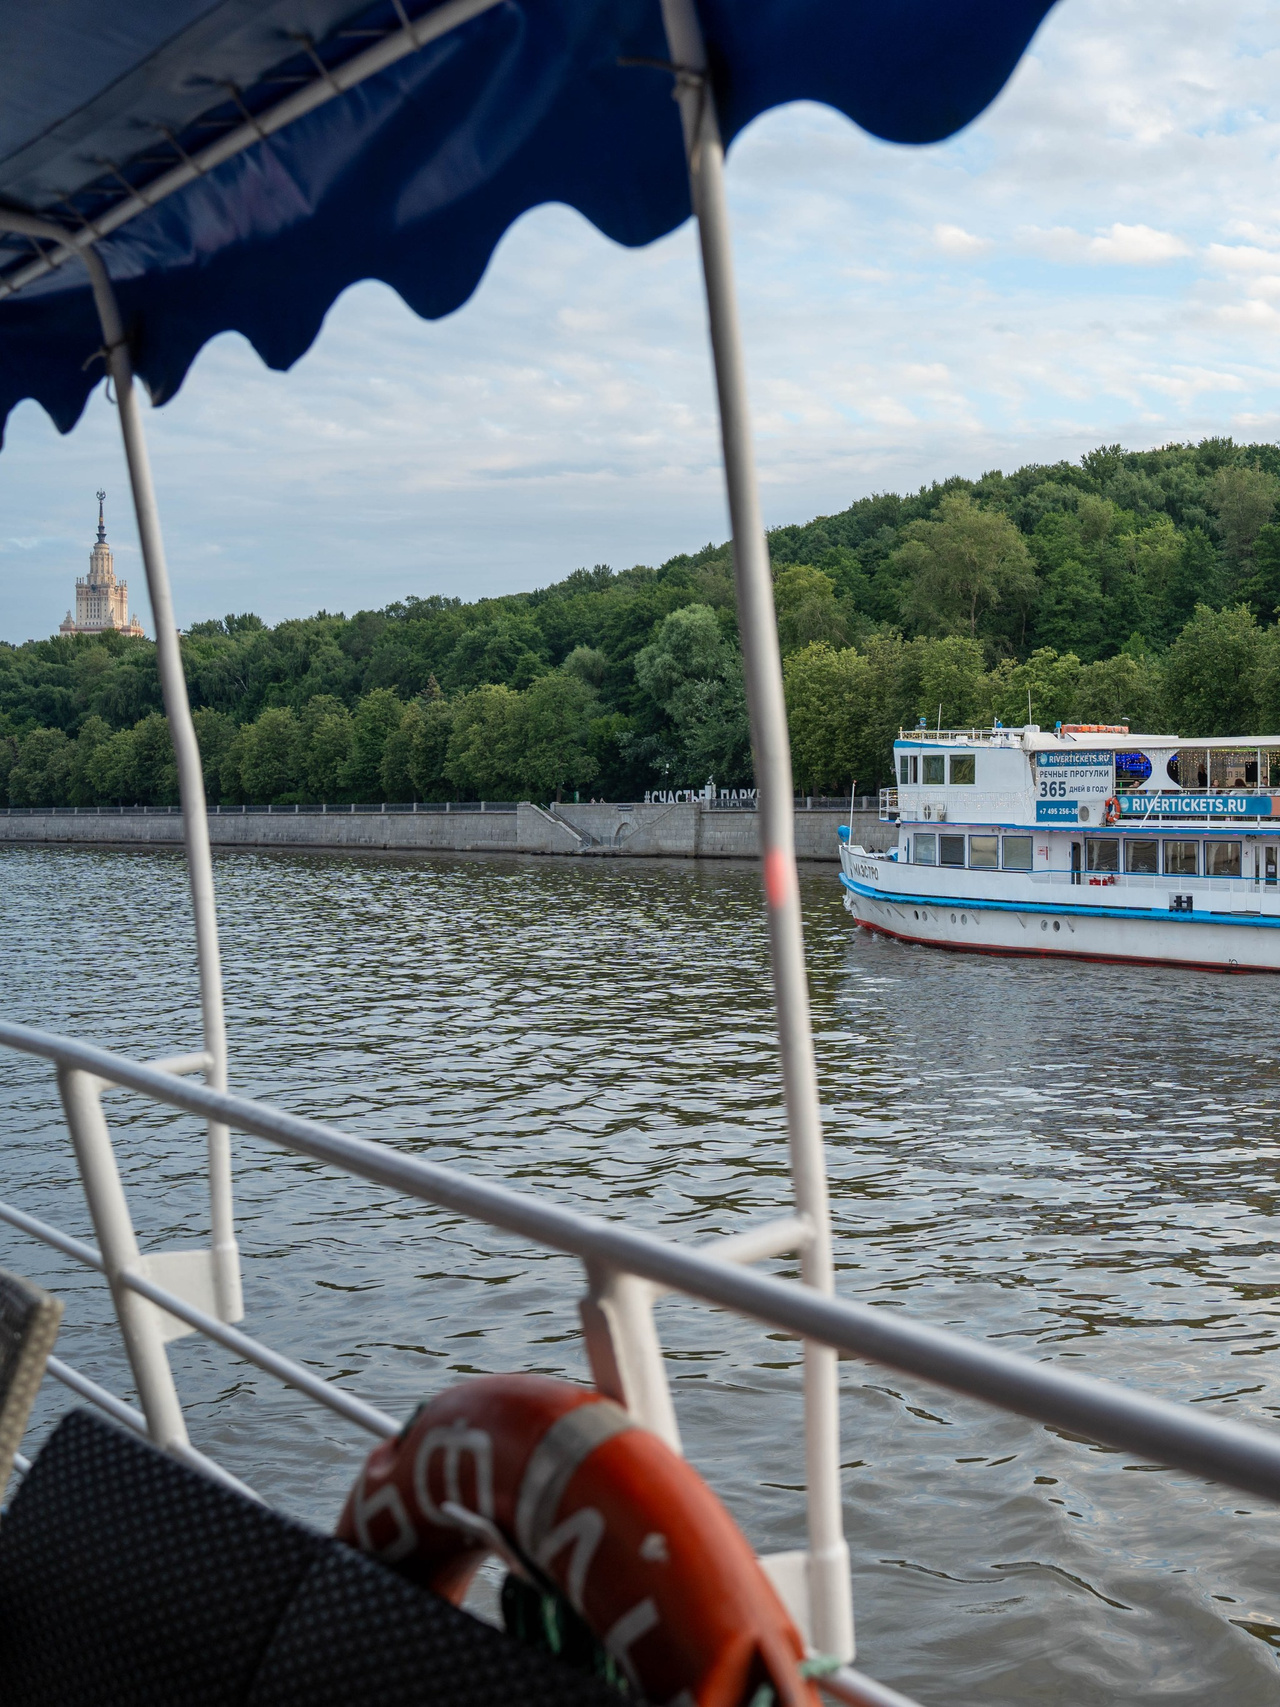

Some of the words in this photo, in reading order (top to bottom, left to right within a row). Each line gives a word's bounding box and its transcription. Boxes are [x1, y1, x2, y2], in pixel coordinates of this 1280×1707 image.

[1049, 754, 1110, 763] RIVERTICKETS.RU
[1040, 770, 1068, 778] РЕЧНЫЕ
[1070, 769, 1109, 778] ПРОГУЛКИ
[1040, 781, 1066, 797] 365
[1069, 785, 1085, 793] ДНЕЙ
[1132, 798, 1246, 812] RIVERTICKETS.RU
